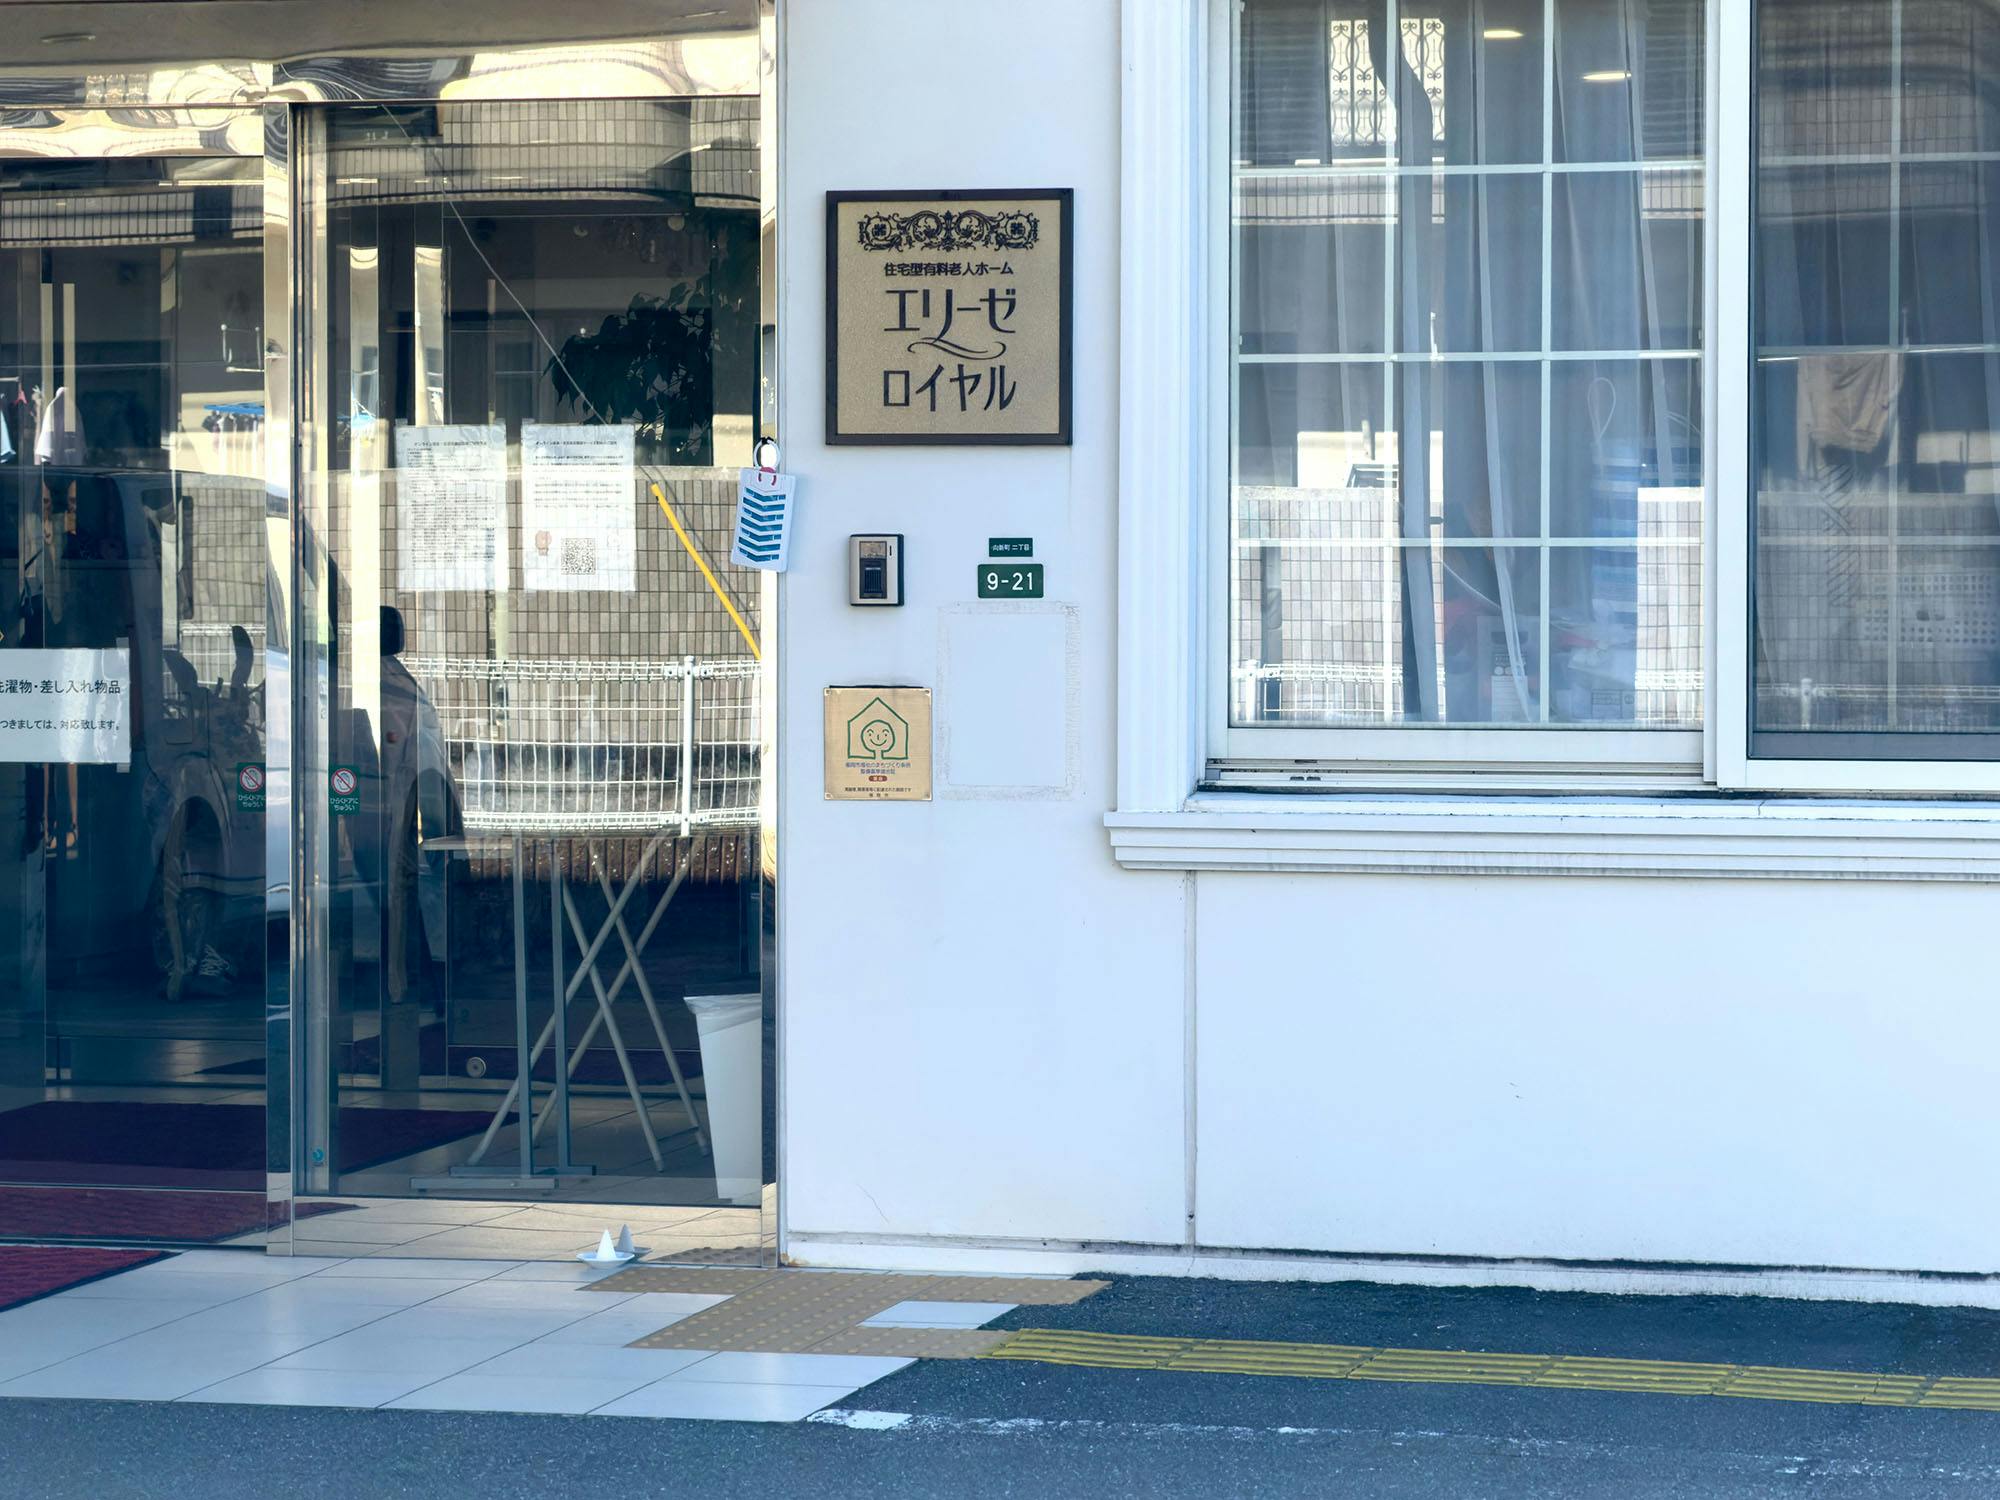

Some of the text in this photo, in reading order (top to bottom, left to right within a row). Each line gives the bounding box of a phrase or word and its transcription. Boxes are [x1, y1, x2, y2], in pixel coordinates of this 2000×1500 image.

[884, 262, 1014, 276] 住宅型有料老人ホーム
[884, 288, 1016, 342] エリーゼ
[884, 364, 1016, 412] ロイヤル
[987, 572, 1033, 591] 9-21
[1, 720, 119, 730] つきましては、対応致します。
